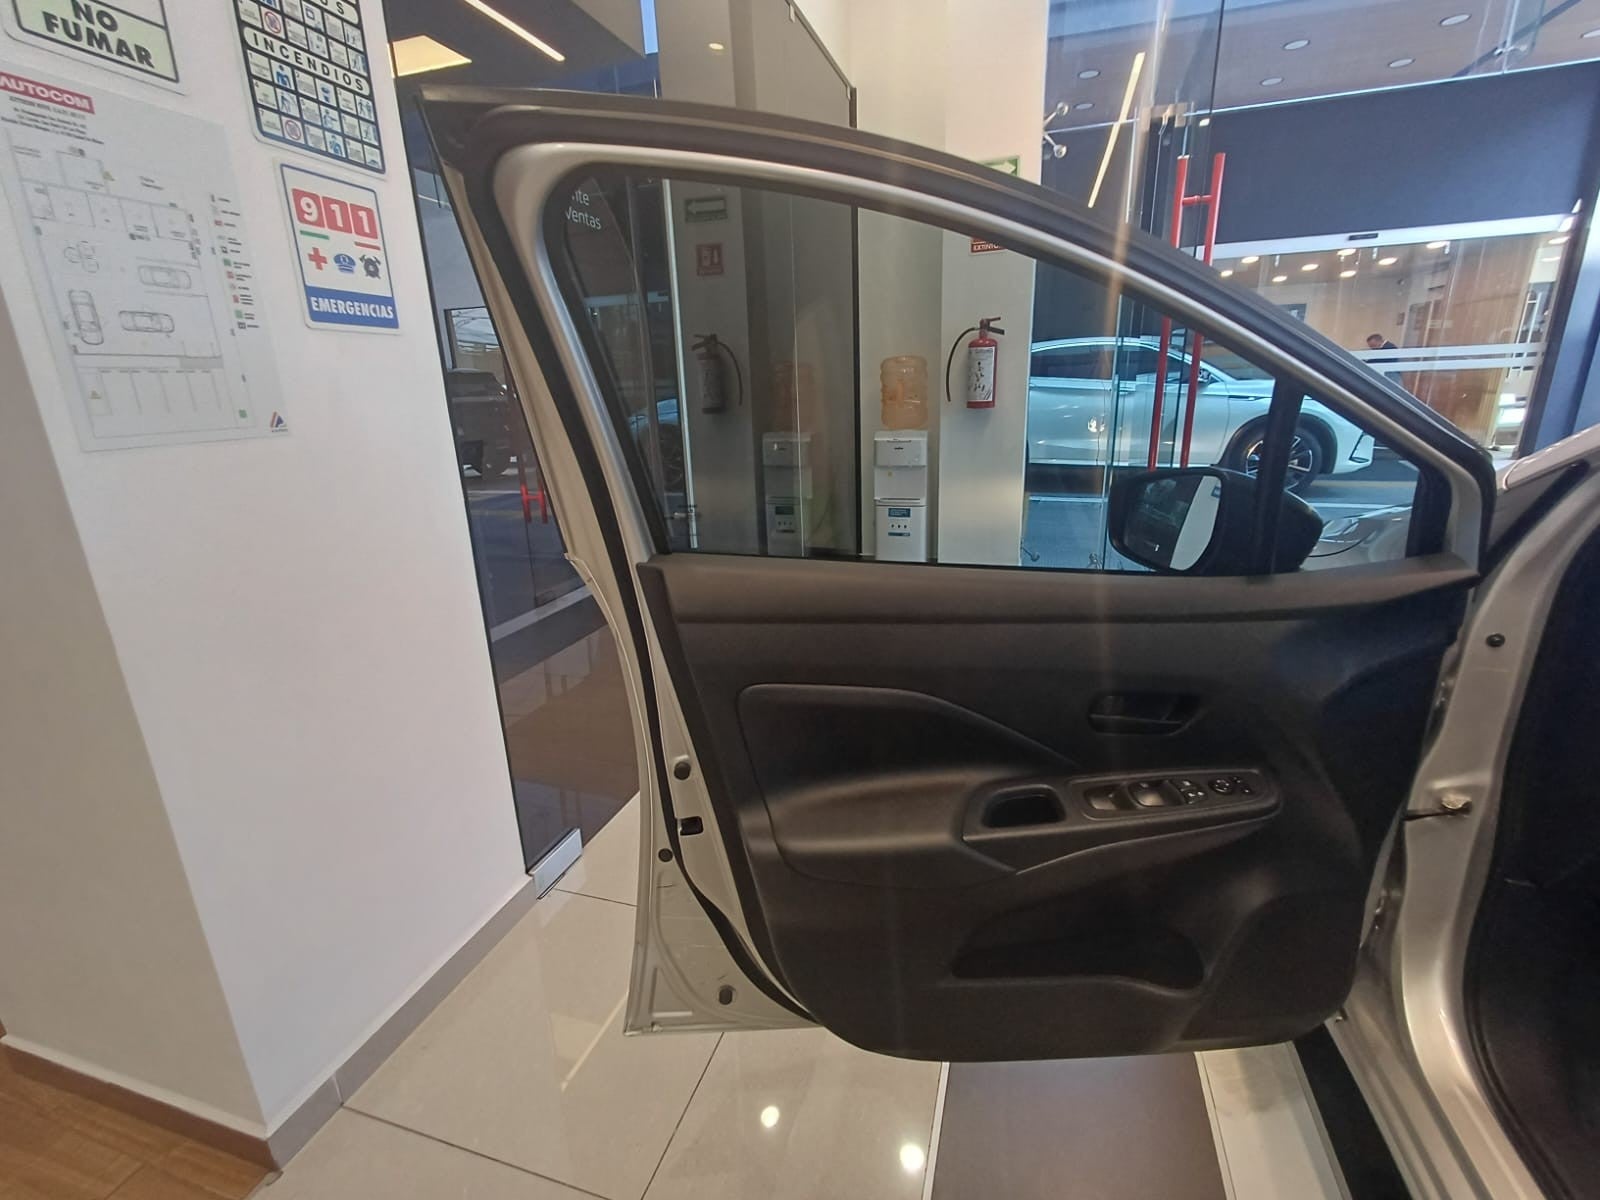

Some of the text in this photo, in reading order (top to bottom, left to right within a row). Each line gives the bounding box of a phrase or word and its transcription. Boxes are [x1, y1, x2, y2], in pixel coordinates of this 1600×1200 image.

[71, 0, 118, 32] NO
[42, 11, 155, 69] FUMAR
[253, 33, 364, 91] INCENDIOS
[0, 76, 91, 110] AUTOCOM
[300, 196, 371, 234] 911
[564, 205, 602, 230] Ventas
[310, 296, 394, 319] EMERGENCIAS
